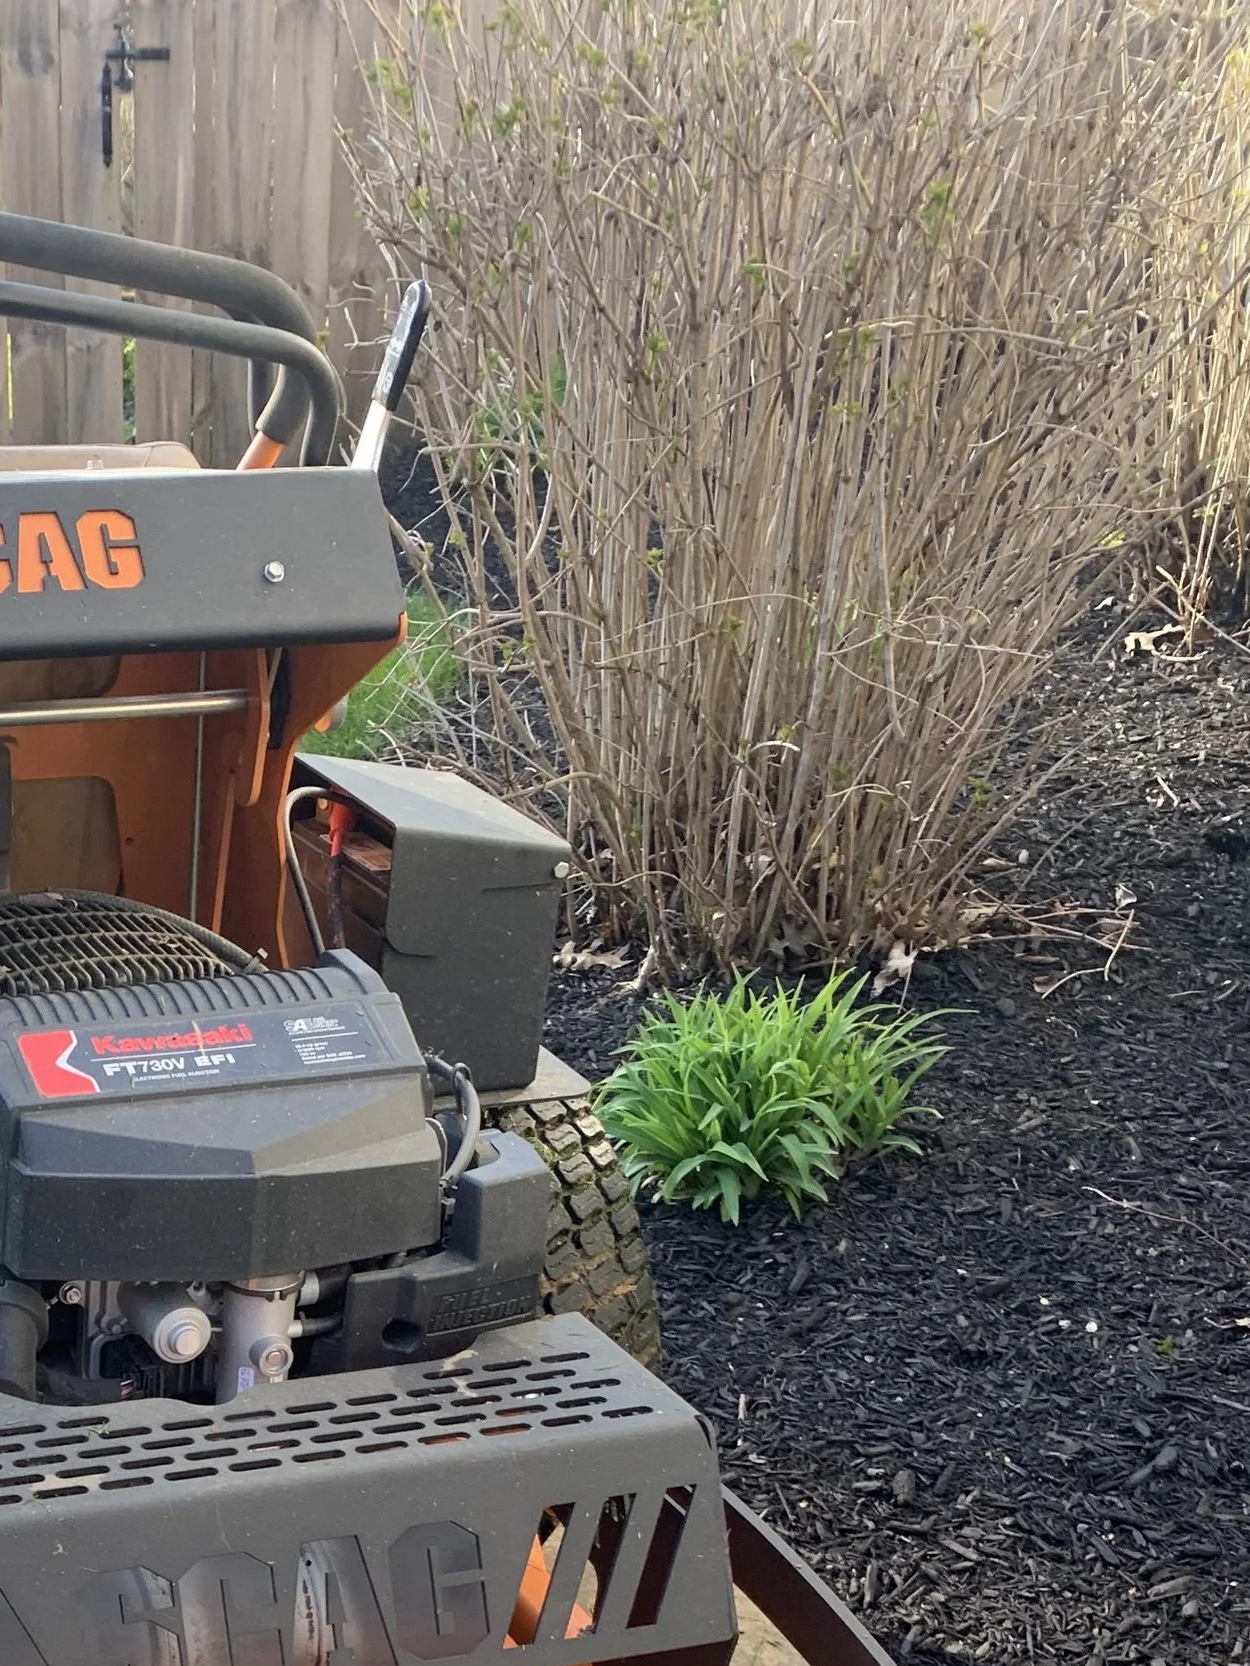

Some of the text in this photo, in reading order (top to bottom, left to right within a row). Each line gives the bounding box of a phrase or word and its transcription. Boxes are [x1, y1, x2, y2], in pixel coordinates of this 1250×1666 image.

[90, 1023, 254, 1056] Kawasaki
[102, 1053, 236, 1077] FT730V EFI
